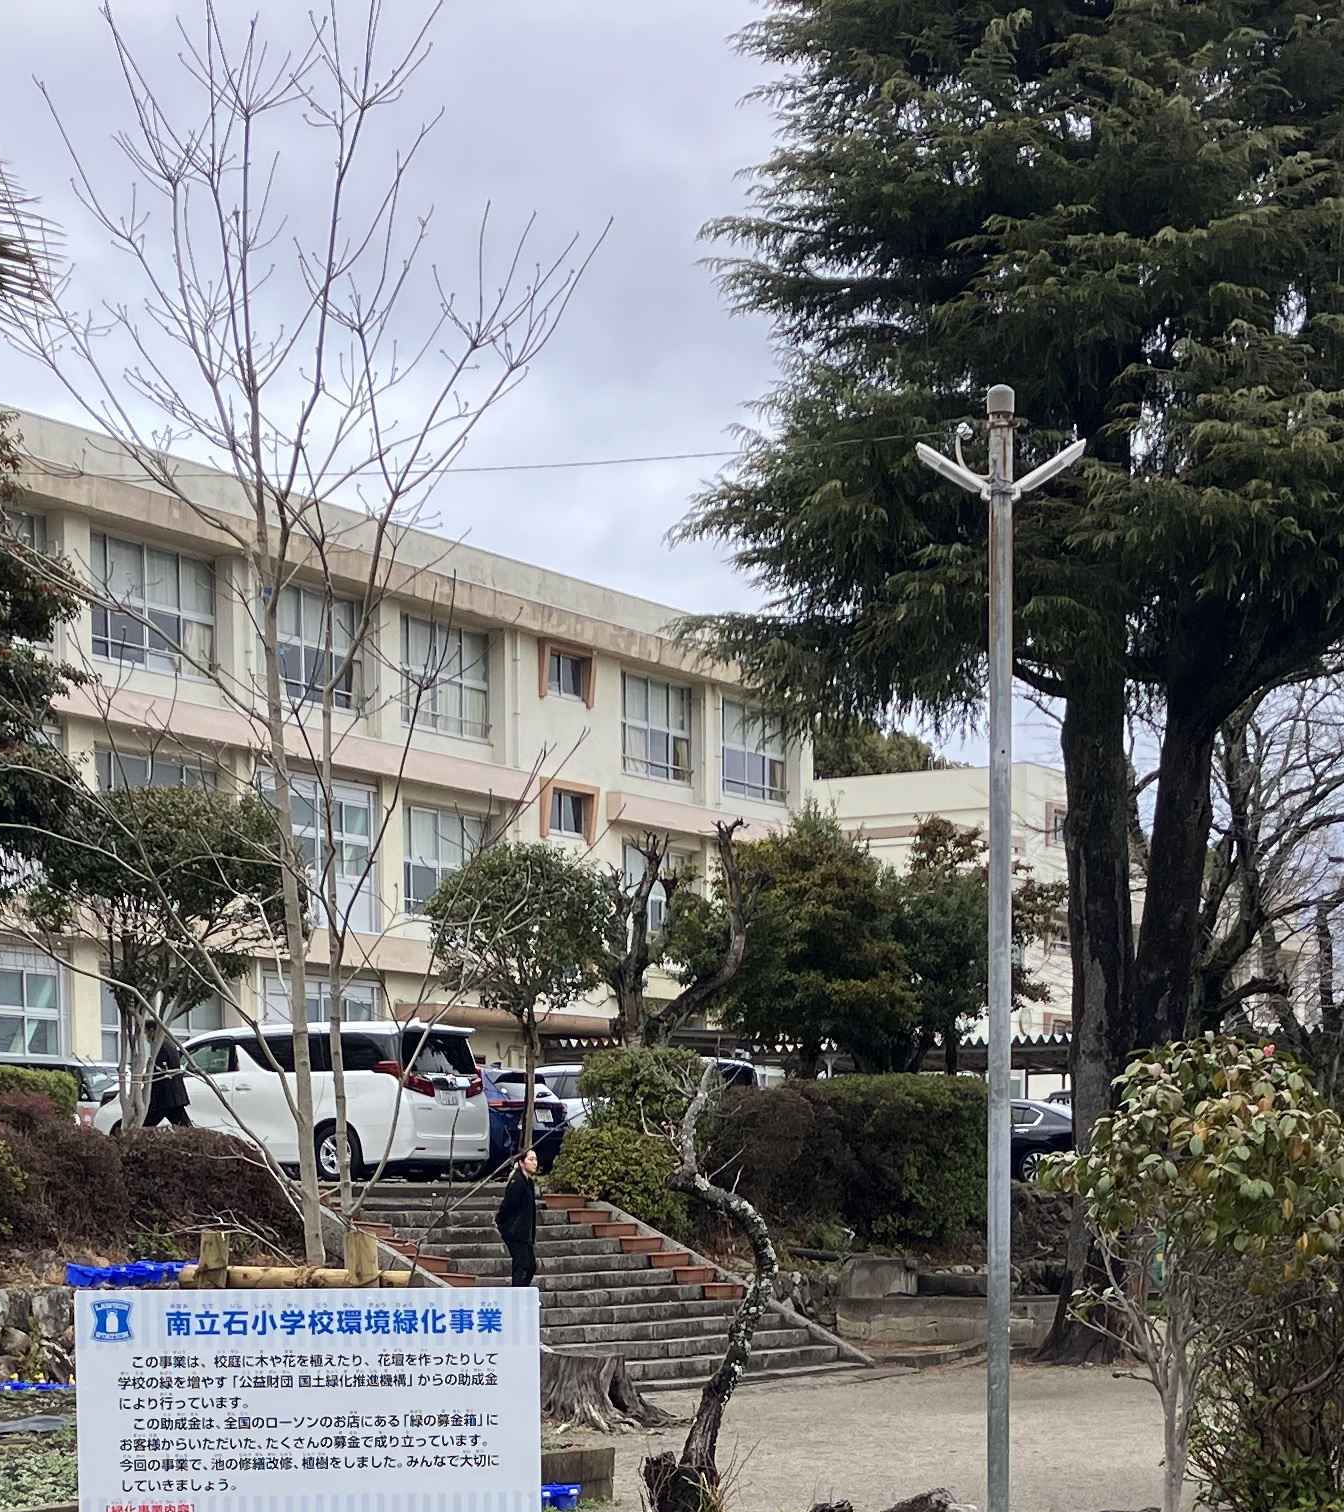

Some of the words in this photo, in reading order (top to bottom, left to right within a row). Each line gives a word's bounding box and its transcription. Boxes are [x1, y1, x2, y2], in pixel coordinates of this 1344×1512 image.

[165, 1309, 503, 1337] 南立石小学校環境緑化事業
[119, 1397, 249, 1410] により行っています。
[122, 1479, 237, 1492] していきましょう。
